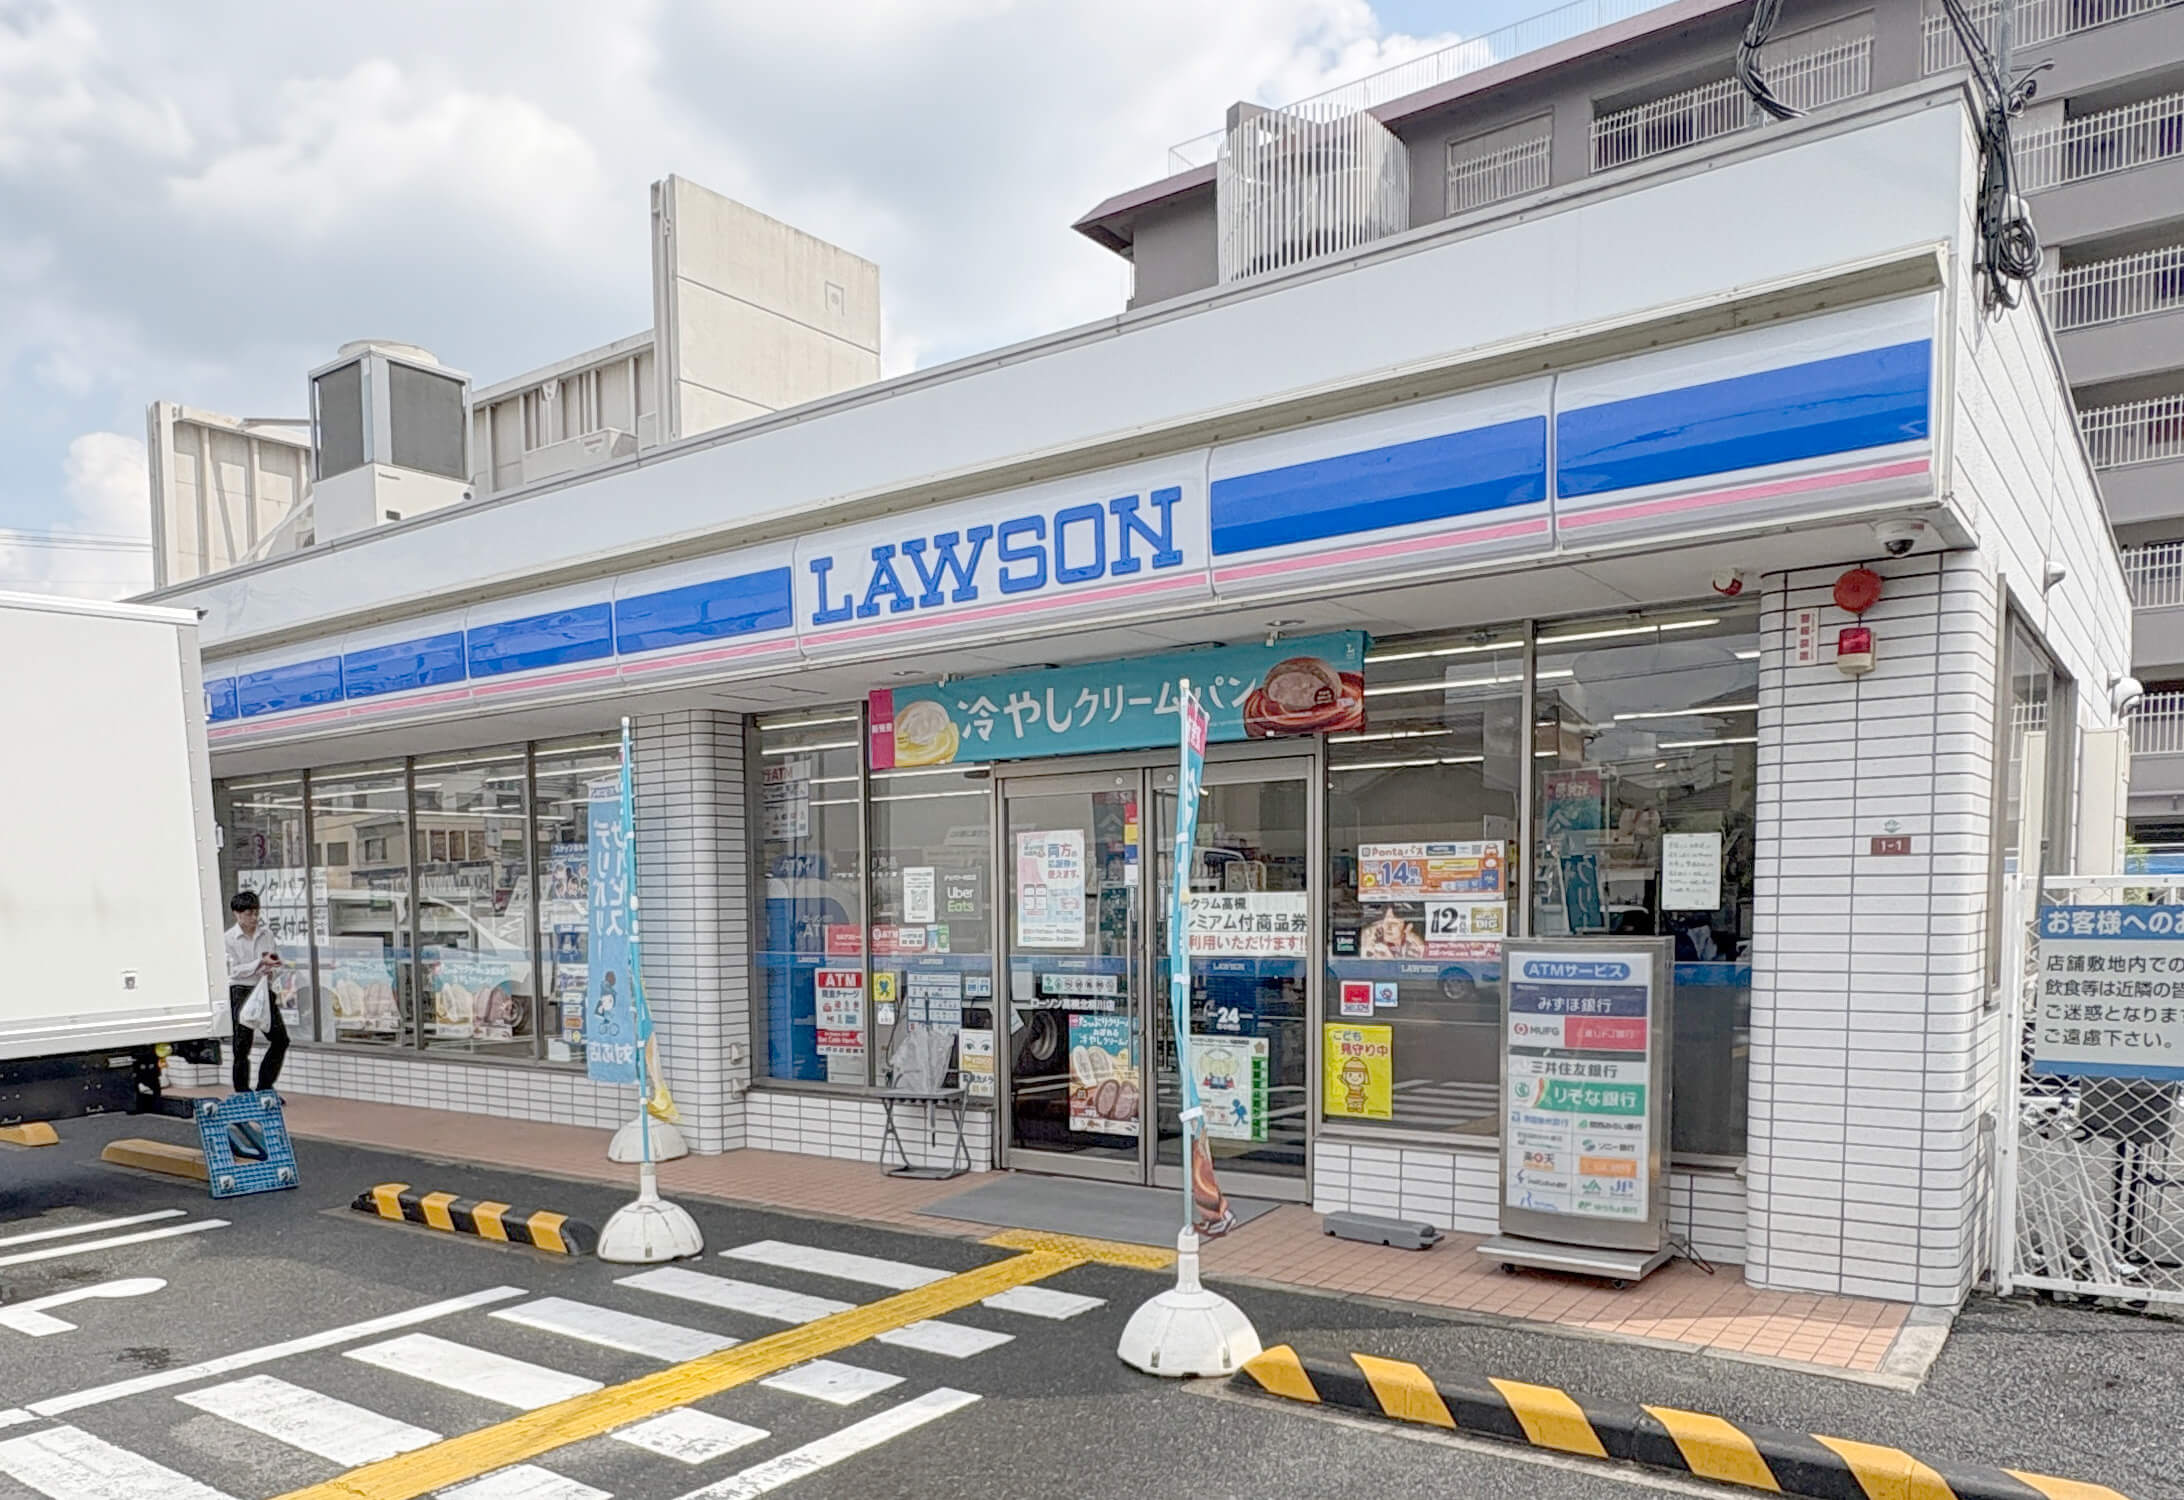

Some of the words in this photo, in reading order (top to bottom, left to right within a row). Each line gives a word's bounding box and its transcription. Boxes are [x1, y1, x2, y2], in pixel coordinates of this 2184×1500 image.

[809, 486, 1183, 626] LAWSON
[1880, 839, 1903, 852] 1-1
[947, 886, 975, 898] Uber
[947, 900, 975, 912] Eats
[1431, 907, 1458, 934] 12
[258, 915, 309, 942] 受付中
[1529, 963, 1623, 977] ATMサービス
[826, 974, 857, 986] ATM
[1538, 997, 1612, 1012] みずほ銀行
[2046, 1004, 2184, 1023] ご迷惑となりま
[1334, 1031, 1362, 1041] こども
[1530, 1025, 1560, 1037] MUFG
[2044, 1028, 2172, 1048] ご遠慮下さい。
[1341, 1043, 1388, 1056] 見守り中
[1531, 1061, 1618, 1079] 三井住友銀行
[1554, 1087, 1637, 1108] りそな銀行
